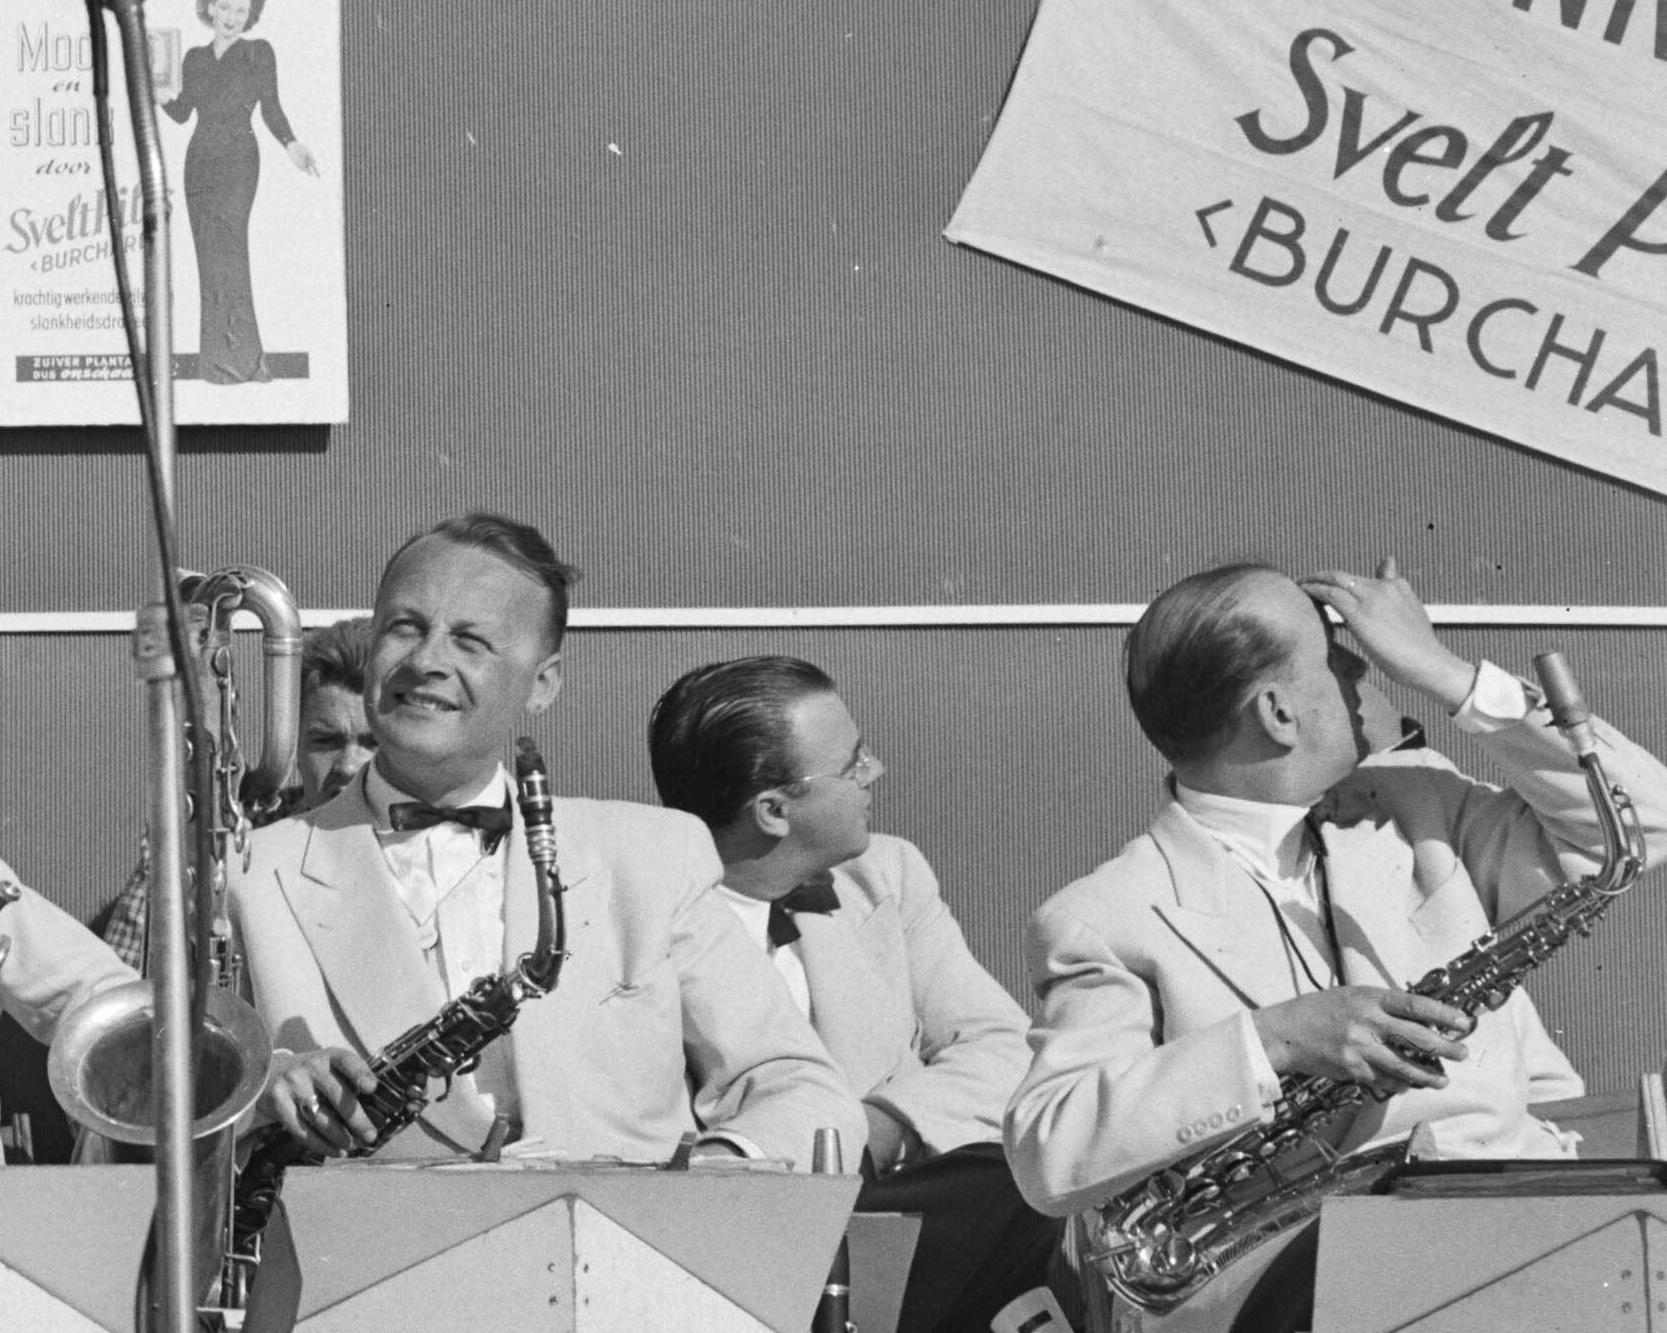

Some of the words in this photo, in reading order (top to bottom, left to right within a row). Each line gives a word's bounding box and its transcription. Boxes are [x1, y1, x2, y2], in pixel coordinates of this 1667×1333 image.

[18, 21, 94, 73] Moo
[52, 79, 81, 94] en
[1234, 28, 1574, 242] Svelt
[36, 159, 91, 175] door
[14, 289, 62, 309] krachtig
[33, 357, 80, 367] ZUIVER
